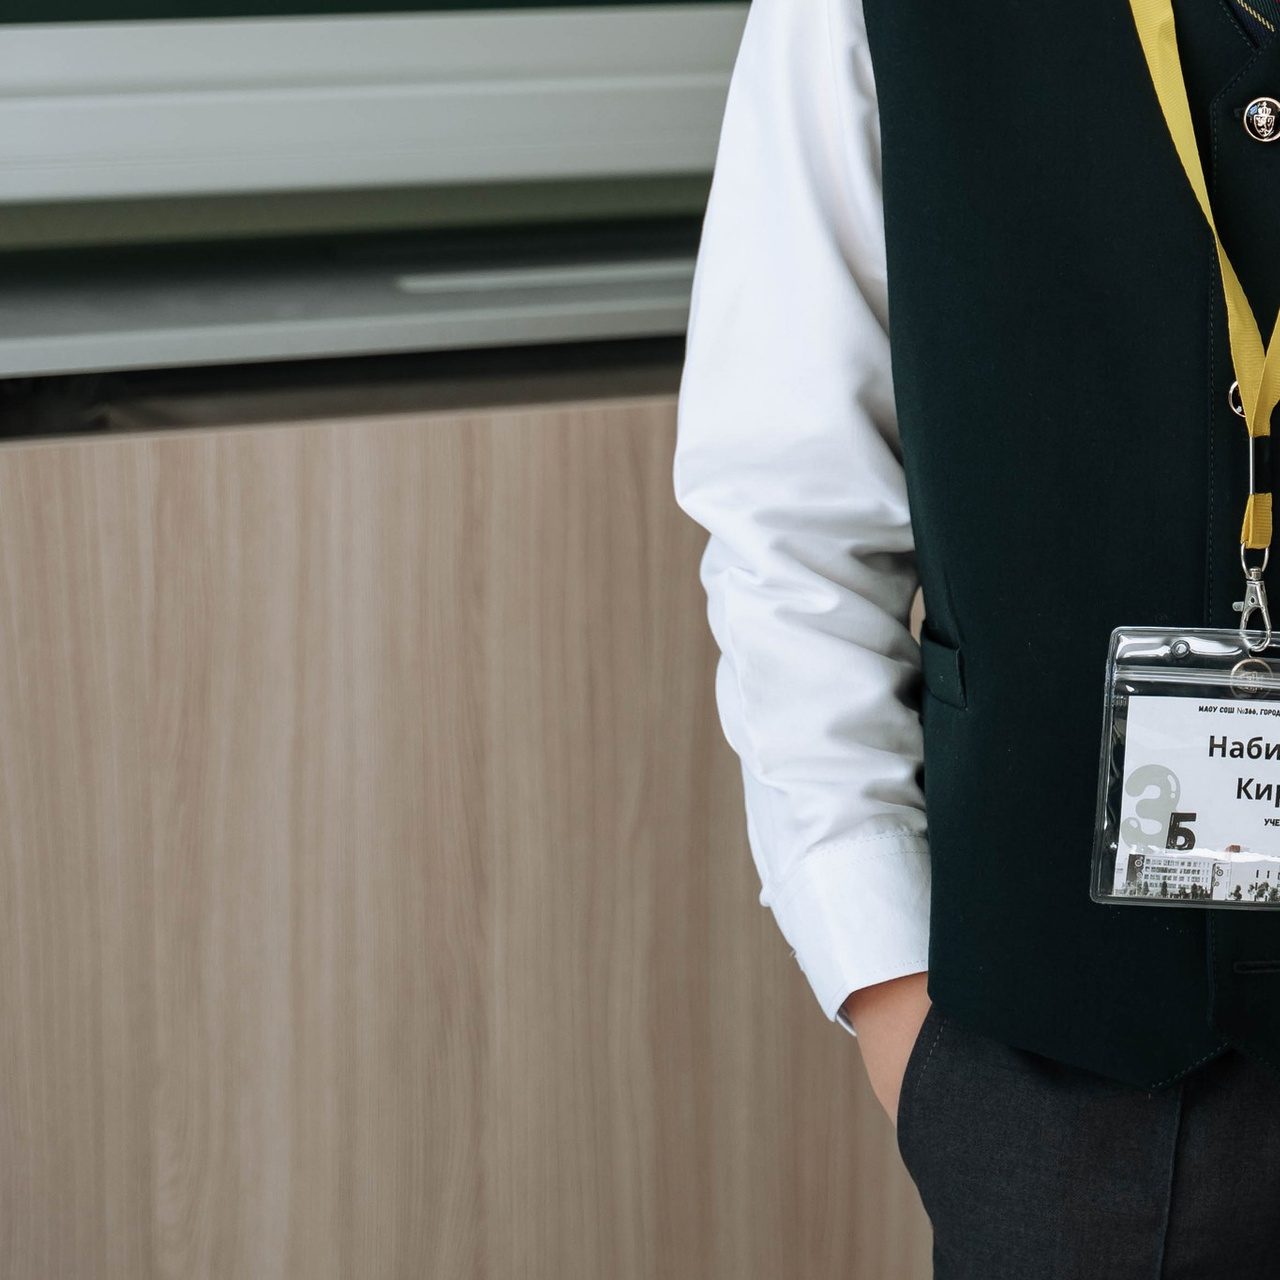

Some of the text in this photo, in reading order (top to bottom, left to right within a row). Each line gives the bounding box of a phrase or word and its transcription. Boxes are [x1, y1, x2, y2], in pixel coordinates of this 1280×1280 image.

[1198, 705, 1218, 713] МАОУ
[1219, 706, 1235, 714] СОШ
[1259, 708, 1280, 718] ГОРОД
